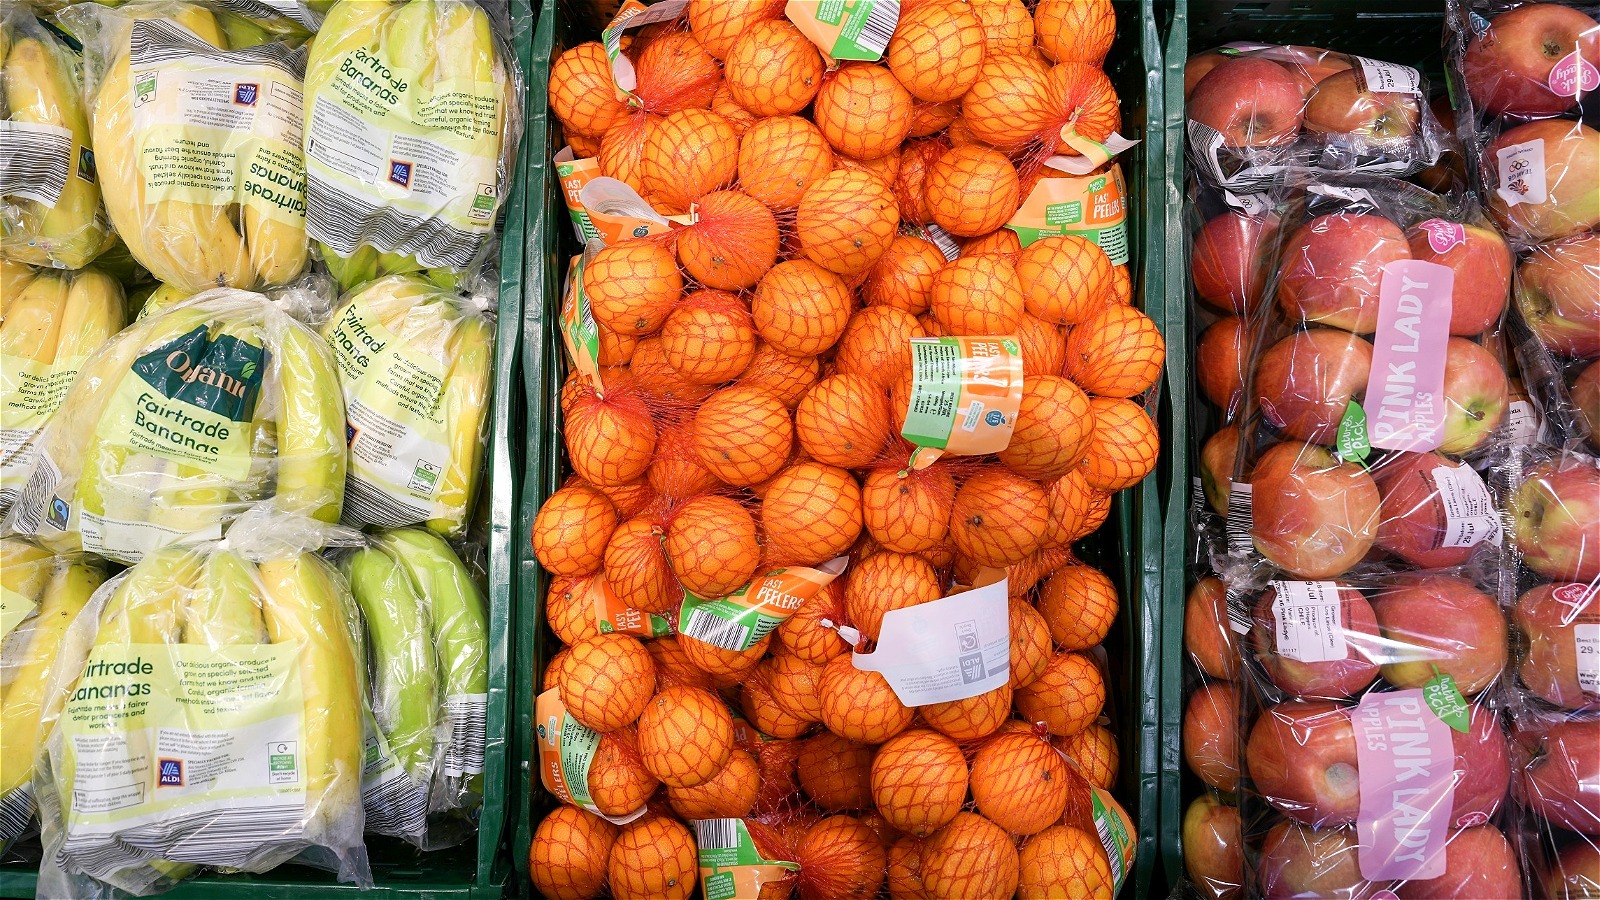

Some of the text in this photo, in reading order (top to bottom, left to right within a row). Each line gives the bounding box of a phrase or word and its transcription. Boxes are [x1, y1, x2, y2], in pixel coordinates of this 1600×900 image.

[340, 58, 399, 105] Bananas
[392, 174, 407, 184] ALDI
[1508, 169, 1532, 181] TEAM GB
[1094, 193, 1109, 204] EAS
[1093, 199, 1119, 219] PEELERS
[1374, 276, 1429, 438] PINK LADY
[397, 401, 409, 409] and
[137, 392, 229, 440] Fairtrade
[1414, 391, 1435, 444] APPLES
[129, 429, 156, 446] Fairtrade
[135, 410, 219, 454] Bananas
[764, 578, 783, 590] EASY
[756, 586, 804, 610] PEELERS
[1307, 587, 1317, 600] Jul
[617, 613, 627, 631] EASY
[1580, 646, 1594, 654] 29
[176, 660, 188, 668] Our
[210, 660, 237, 669] organic
[962, 657, 980, 666] ALDI
[208, 670, 236, 678] specially
[207, 687, 235, 696] organic
[128, 700, 149, 709] fairer
[130, 708, 146, 717] and
[1362, 702, 1387, 752] APPLES
[1384, 696, 1432, 863] PINK LADY
